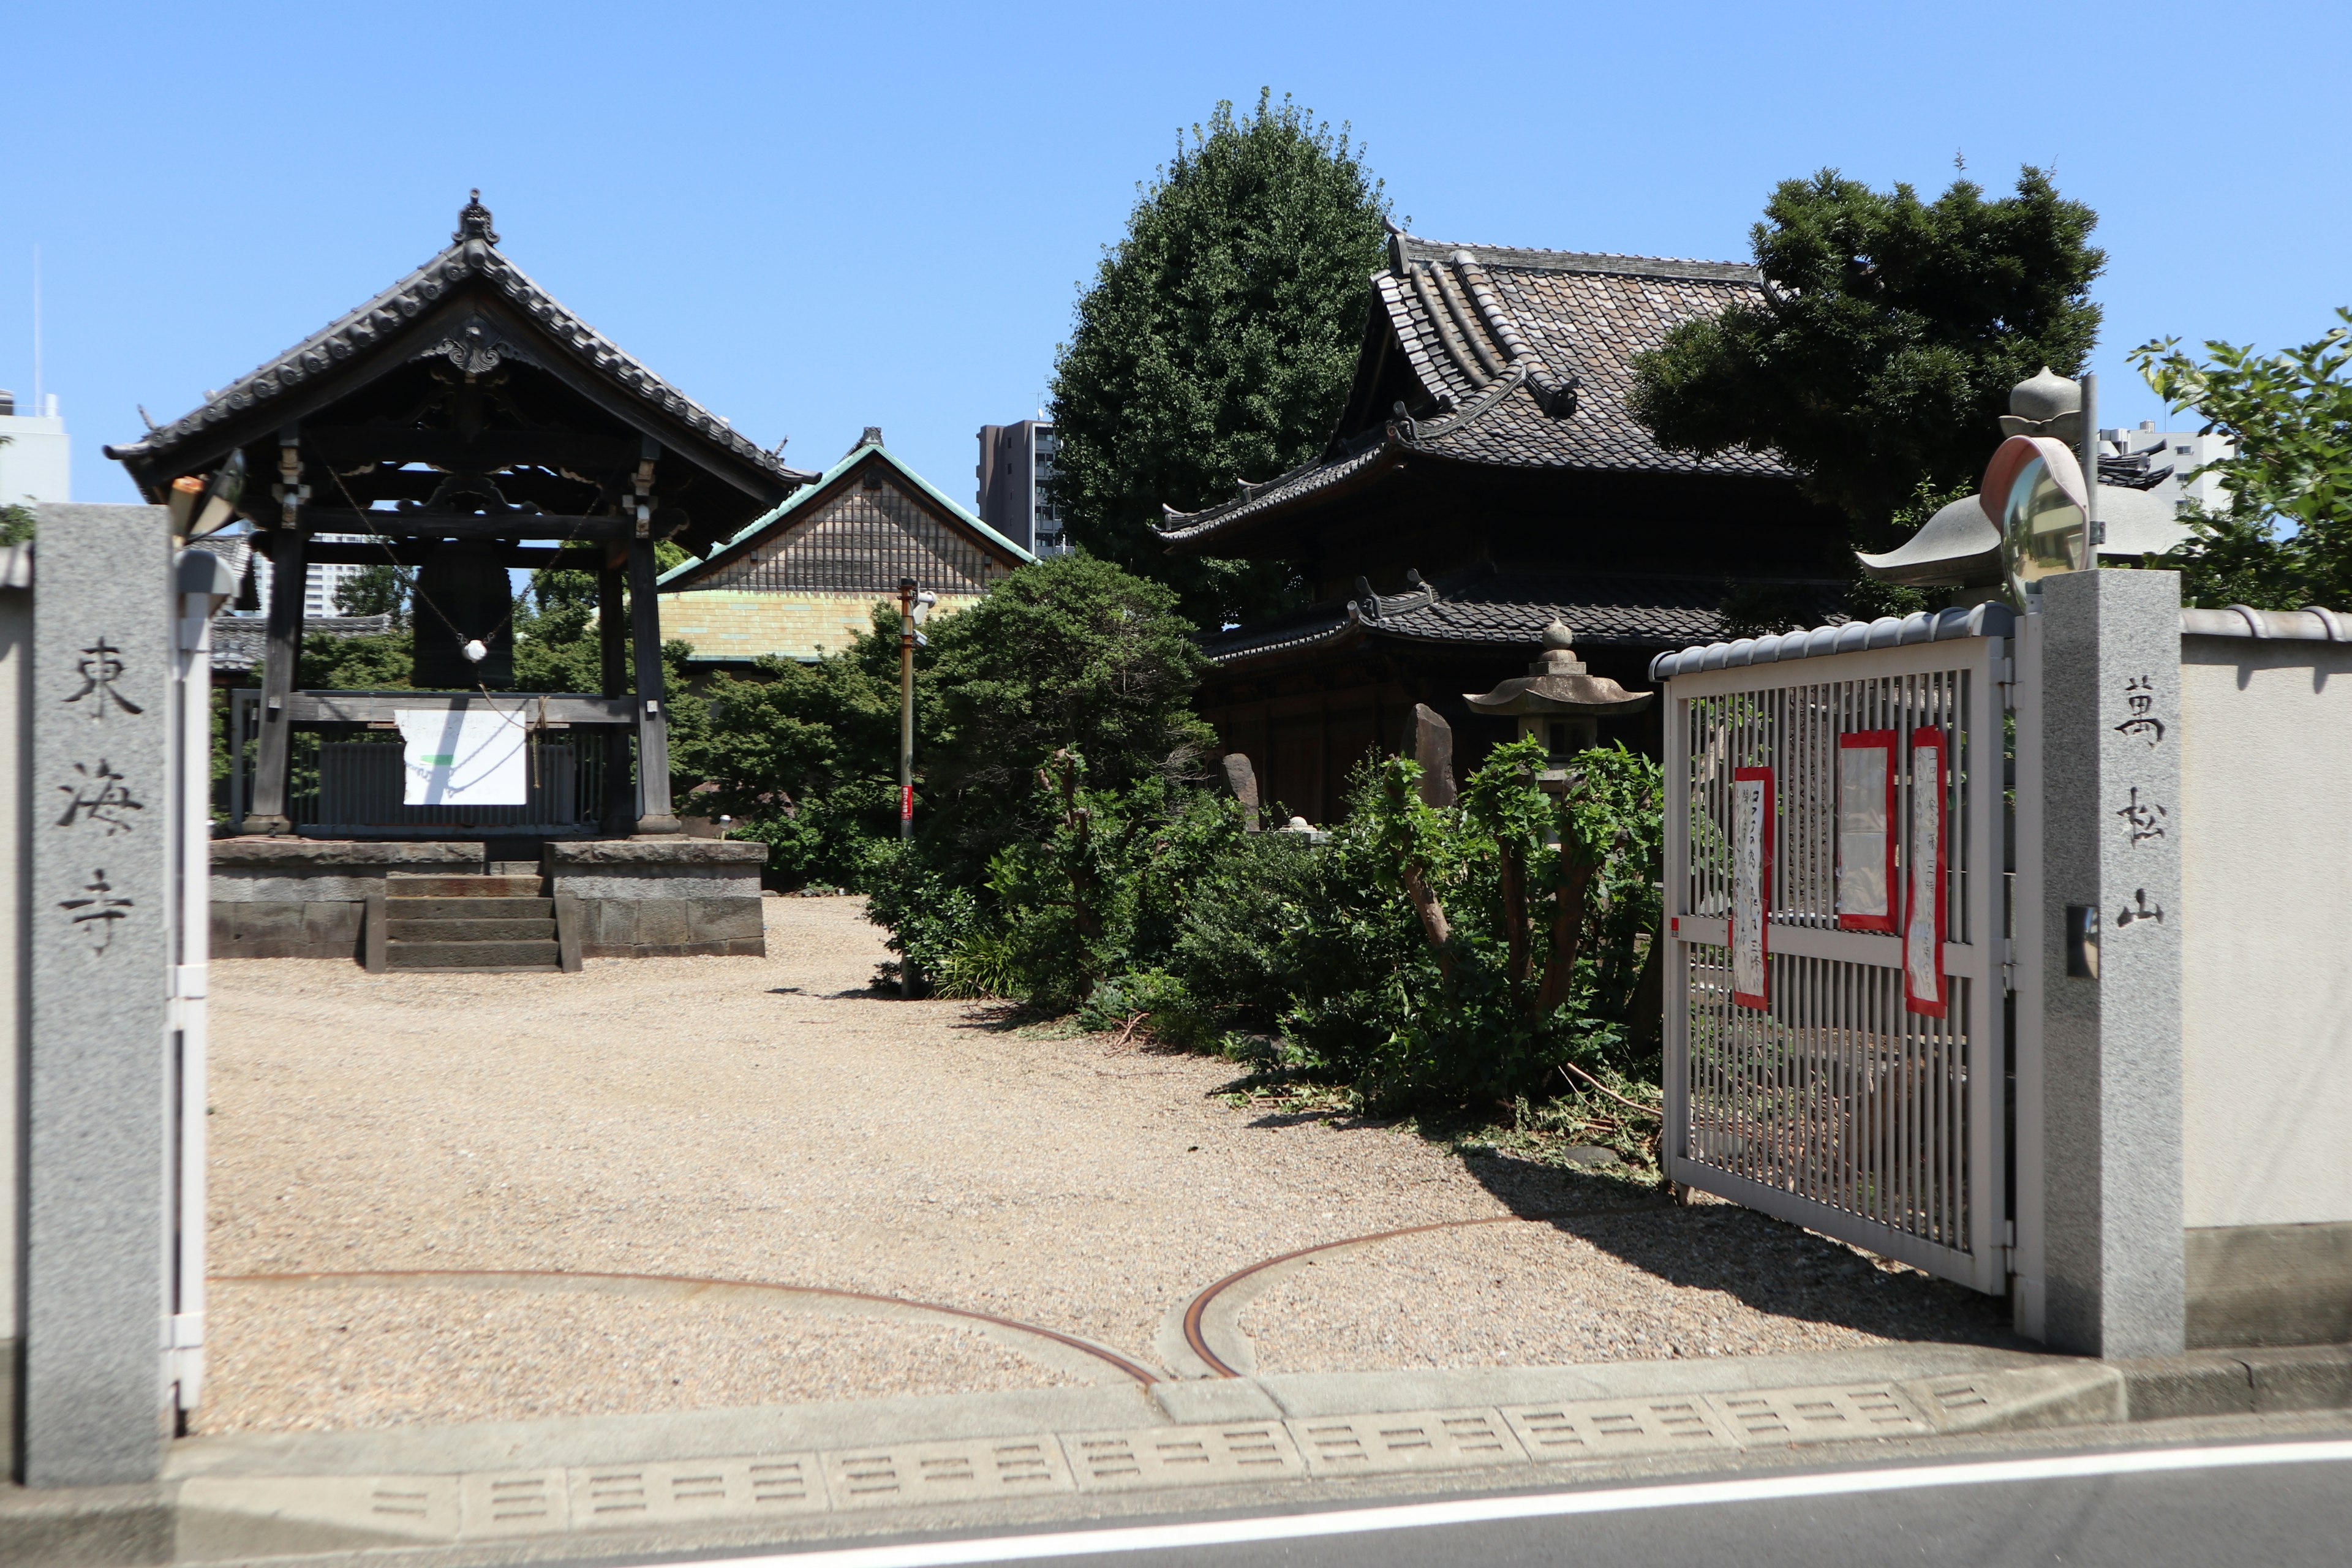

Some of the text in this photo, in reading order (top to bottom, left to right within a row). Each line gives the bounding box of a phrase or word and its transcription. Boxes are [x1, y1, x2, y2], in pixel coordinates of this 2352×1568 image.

[56, 636, 144, 957] 東海寺
[2114, 674, 2166, 929] 萬松山
